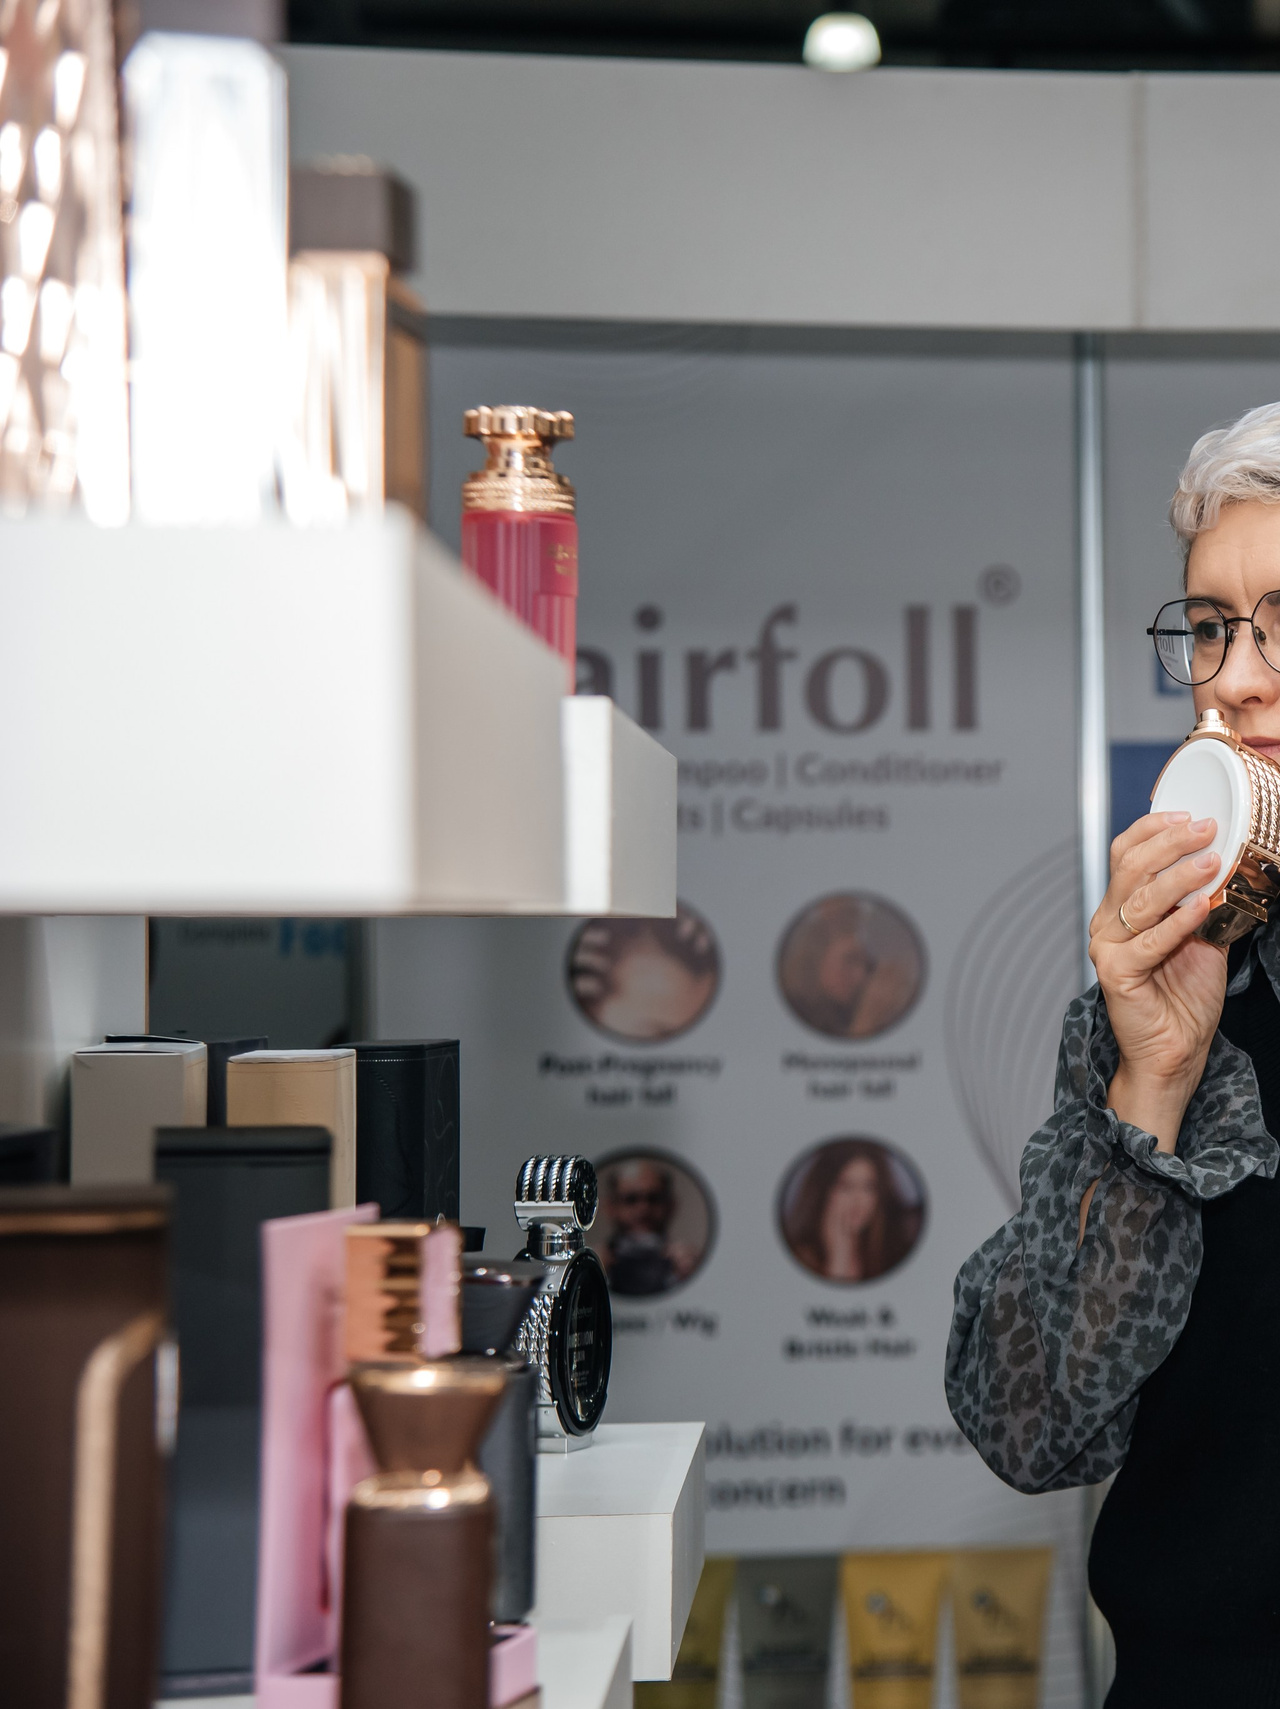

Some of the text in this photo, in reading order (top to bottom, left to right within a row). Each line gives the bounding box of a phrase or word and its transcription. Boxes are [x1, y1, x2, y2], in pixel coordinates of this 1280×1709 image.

[575, 603, 981, 736] airfoll
[793, 750, 1006, 787] Conditioner
[729, 796, 890, 835] Capsules
[705, 1418, 973, 1459] olution for eve
[705, 1476, 847, 1509] oncern
